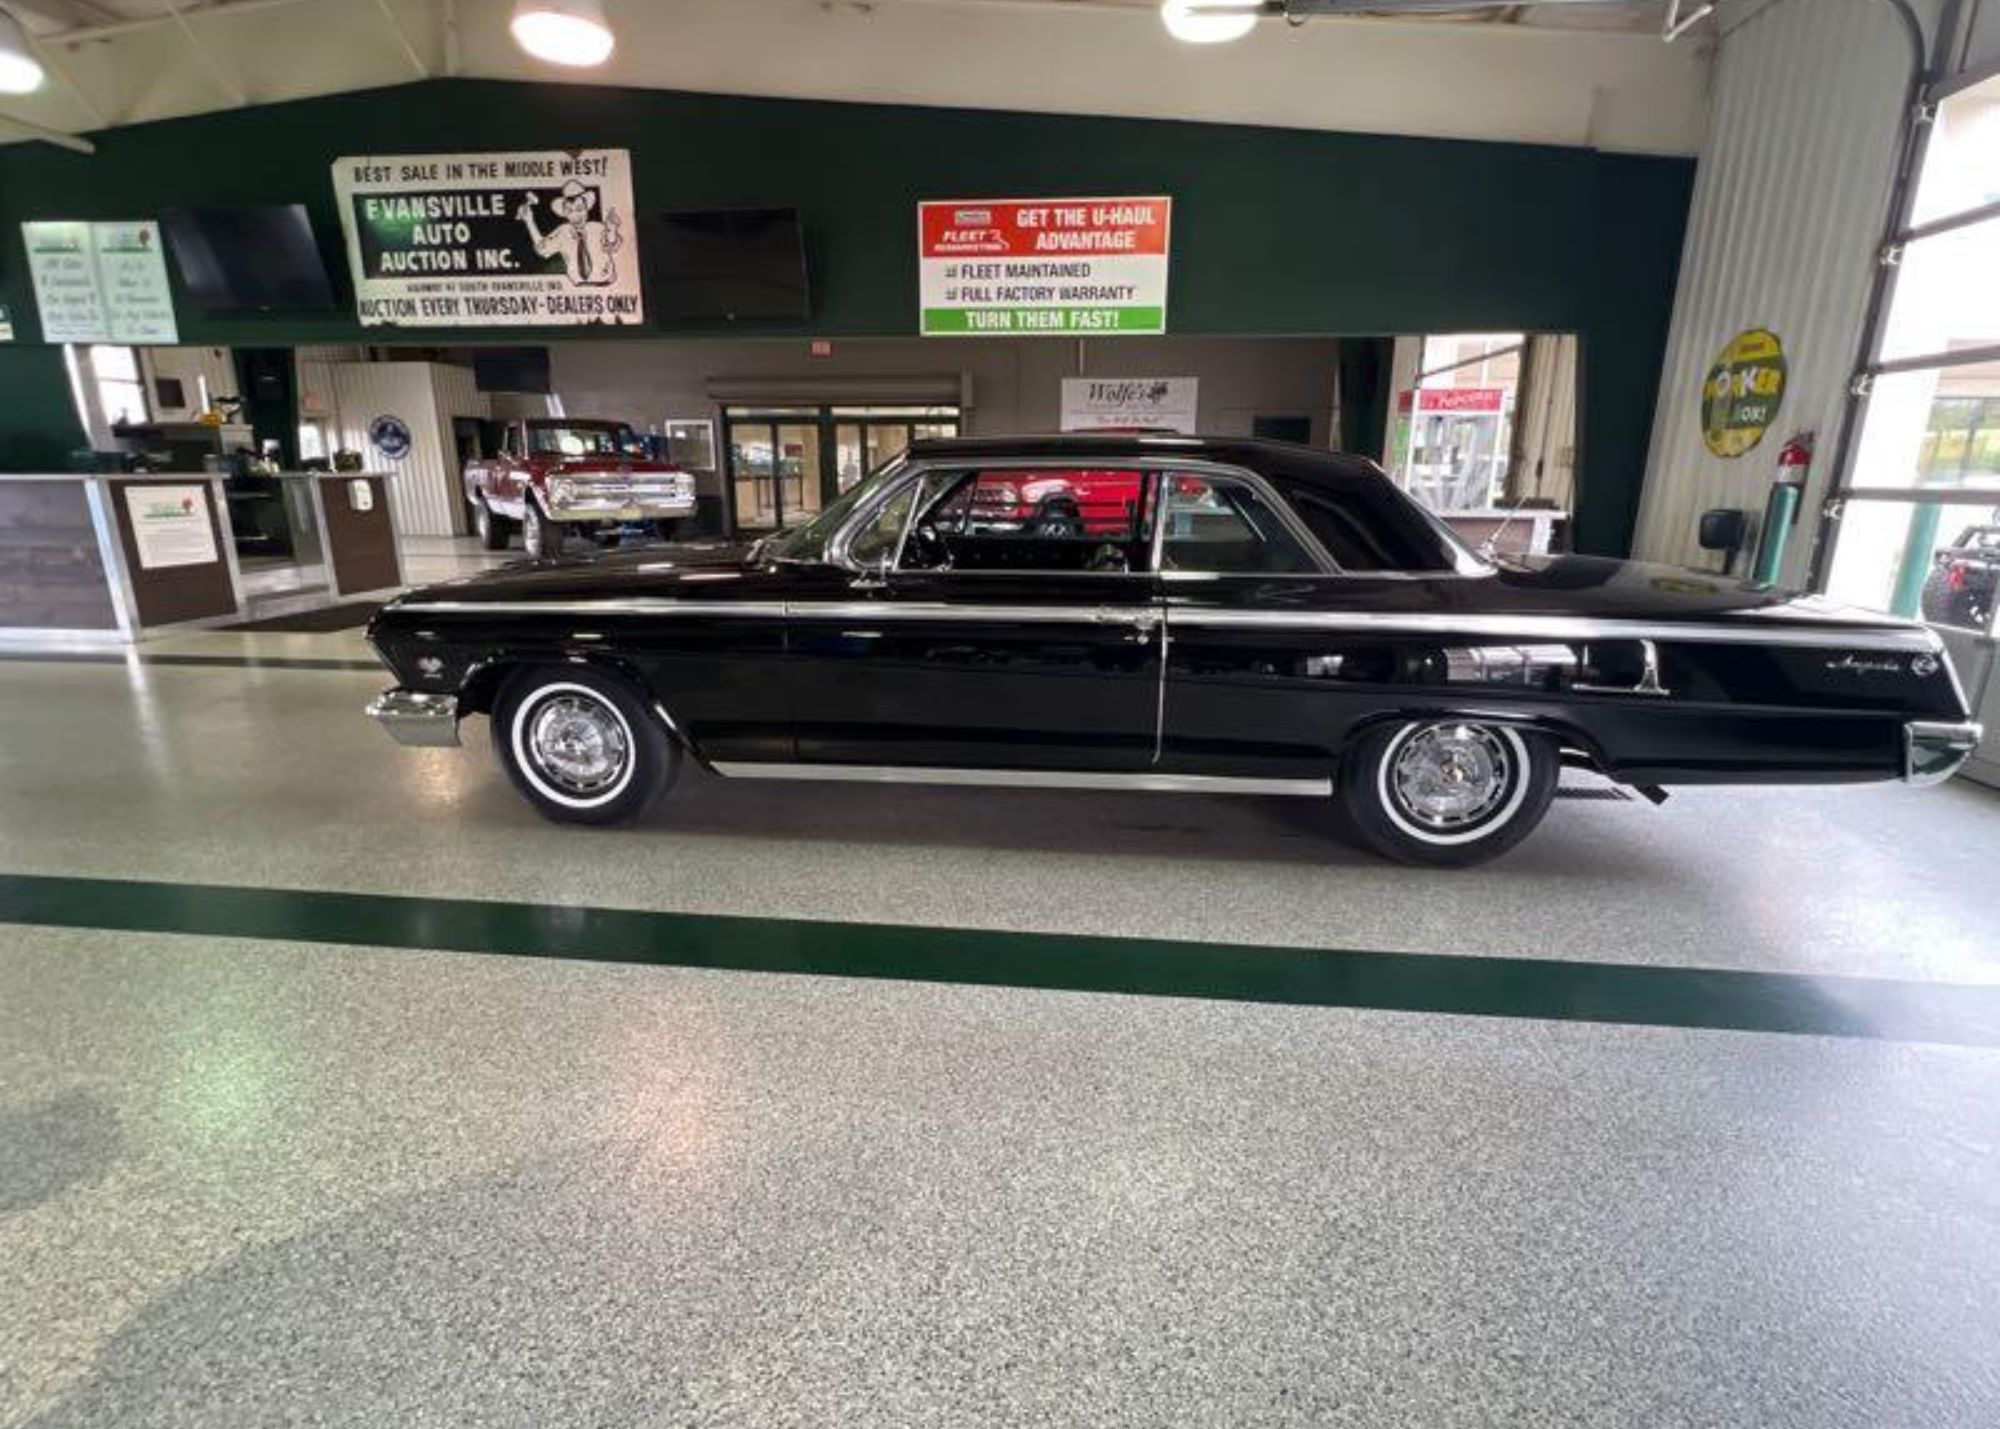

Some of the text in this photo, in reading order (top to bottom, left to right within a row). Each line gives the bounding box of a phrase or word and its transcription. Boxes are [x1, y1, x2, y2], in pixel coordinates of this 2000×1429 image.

[354, 156, 608, 183] BEST SALE IN THE MIDDLE WEST!
[366, 194, 505, 220] EVANSVILLE
[1016, 205, 1156, 227] GET THE U-HAUL
[412, 223, 471, 246] AUTO
[1034, 231, 1136, 251] ADVANTAGE
[381, 248, 520, 272] AUCTION INC.
[961, 263, 1091, 278] FLEET MAINTAINED
[961, 286, 1137, 301] FULL FACTORY WARRANTY
[360, 298, 417, 317] AUCTION
[422, 298, 460, 316] EVERY
[607, 295, 638, 313] ONLY
[965, 310, 1119, 329] TURN THEM FAST!
